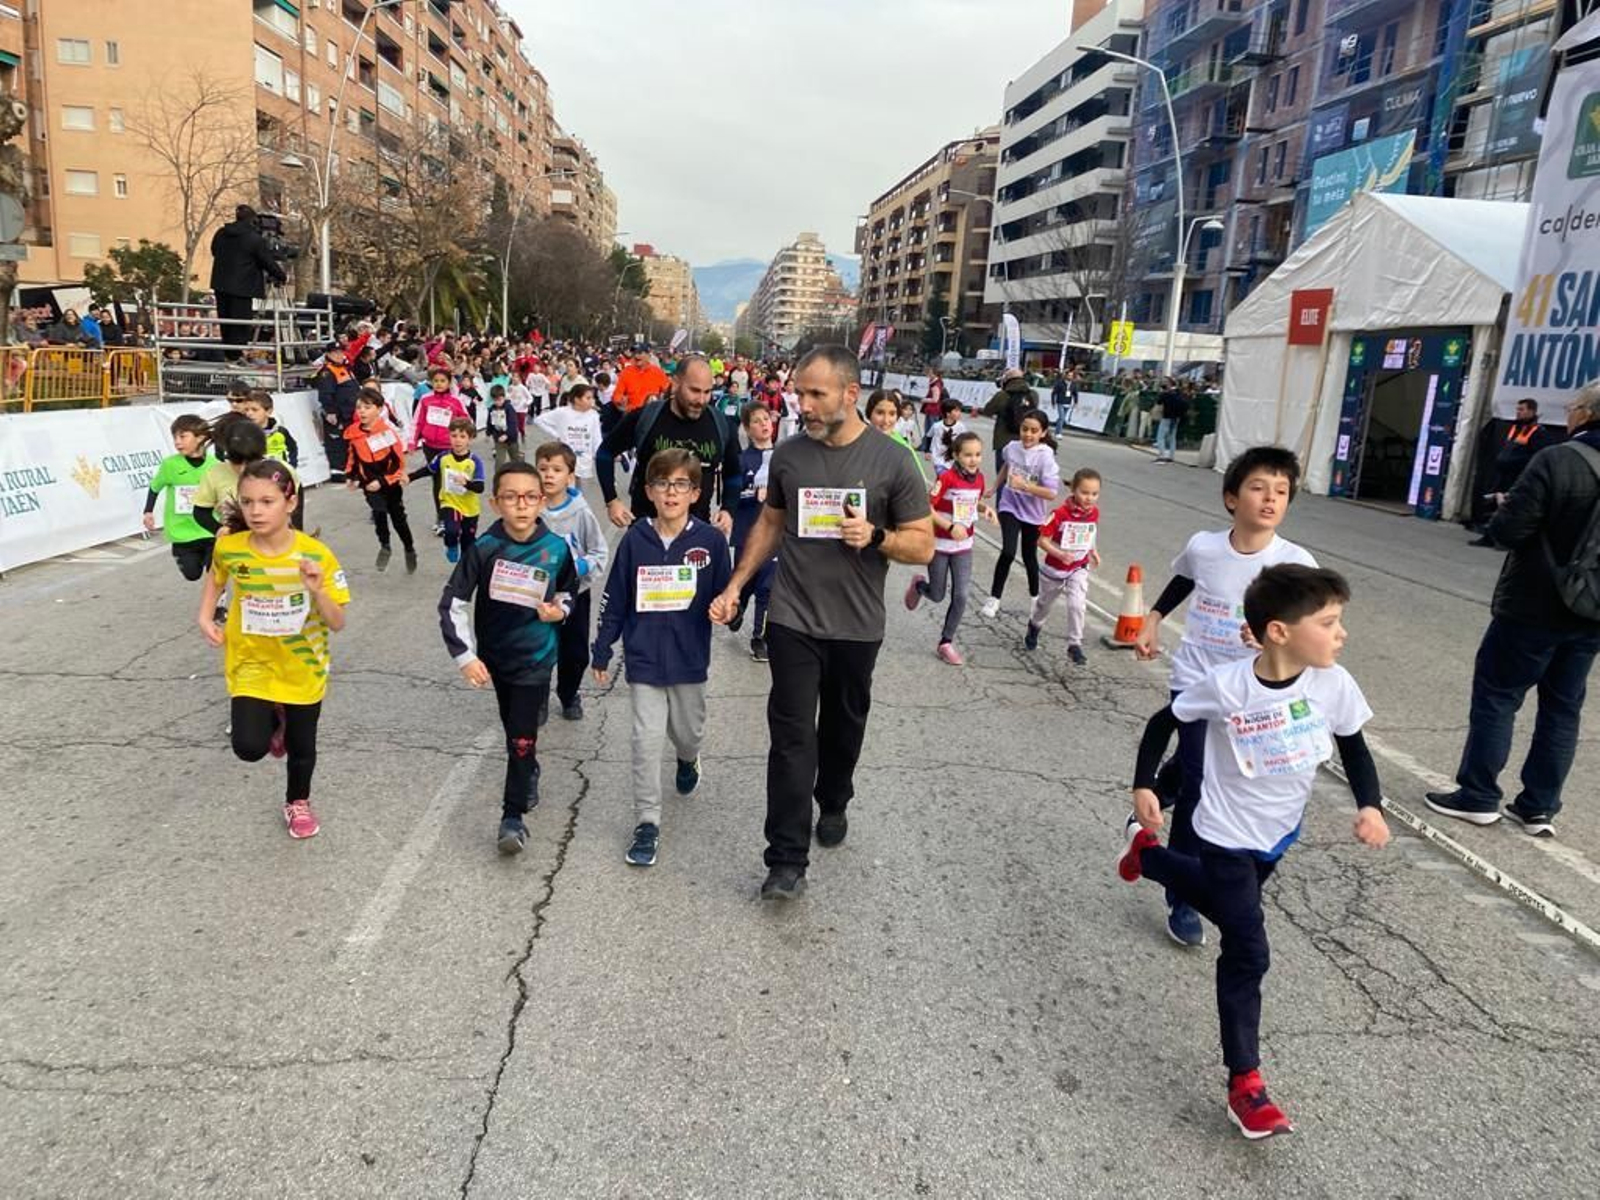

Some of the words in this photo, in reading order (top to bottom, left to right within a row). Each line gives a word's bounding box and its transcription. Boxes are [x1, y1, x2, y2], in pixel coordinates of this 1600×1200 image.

[1301, 308, 1320, 326] ELITE
[1503, 327, 1600, 390] ANTÓN
[102, 454, 130, 473] CAJA
[3, 466, 57, 491] RURAL
[0, 491, 41, 517] JAÉN
[1237, 726, 1255, 735] SAN
[1244, 714, 1271, 725] NOCHE
[1387, 801, 1415, 823] DEPORTES
[1508, 882, 1546, 912] DEPORTES
